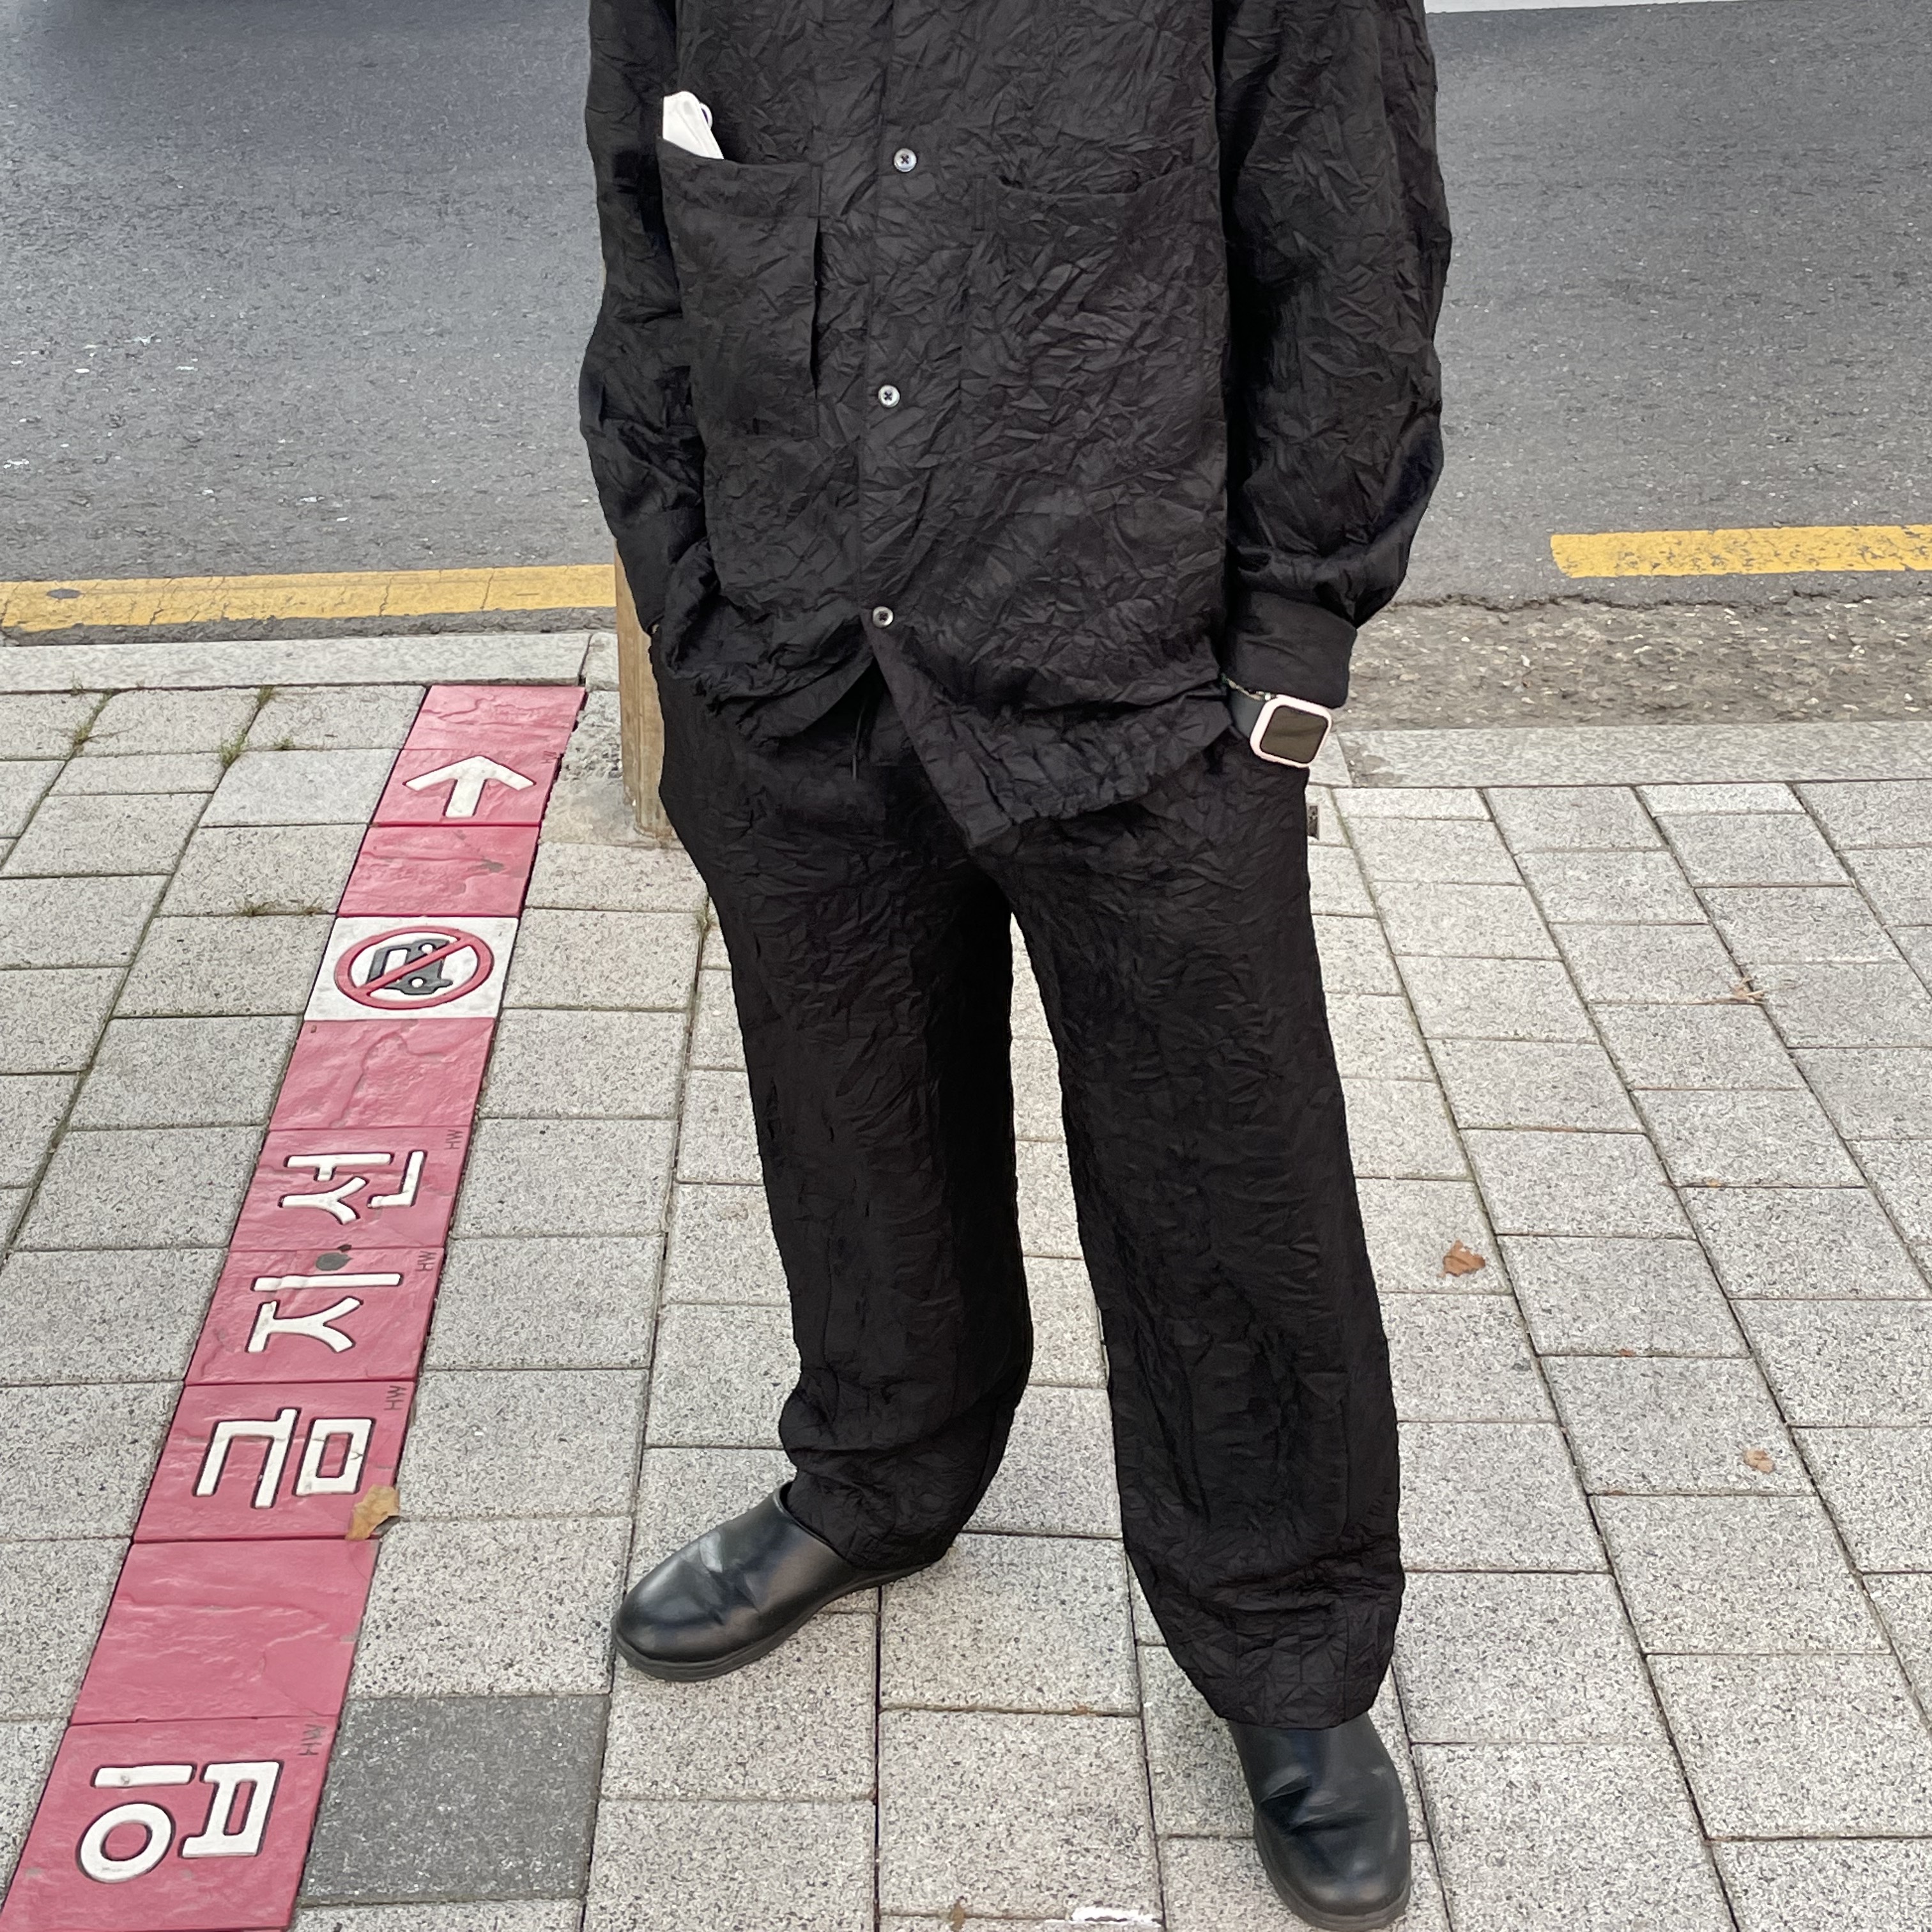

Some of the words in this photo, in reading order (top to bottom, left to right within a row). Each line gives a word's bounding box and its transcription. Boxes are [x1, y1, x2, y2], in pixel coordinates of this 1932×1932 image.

[444, 1129, 464, 1150] HW
[415, 1250, 437, 1271] HW
[383, 1385, 407, 1411] HW
[78, 1761, 282, 1883] 입
[194, 1151, 427, 1508] 금지선
